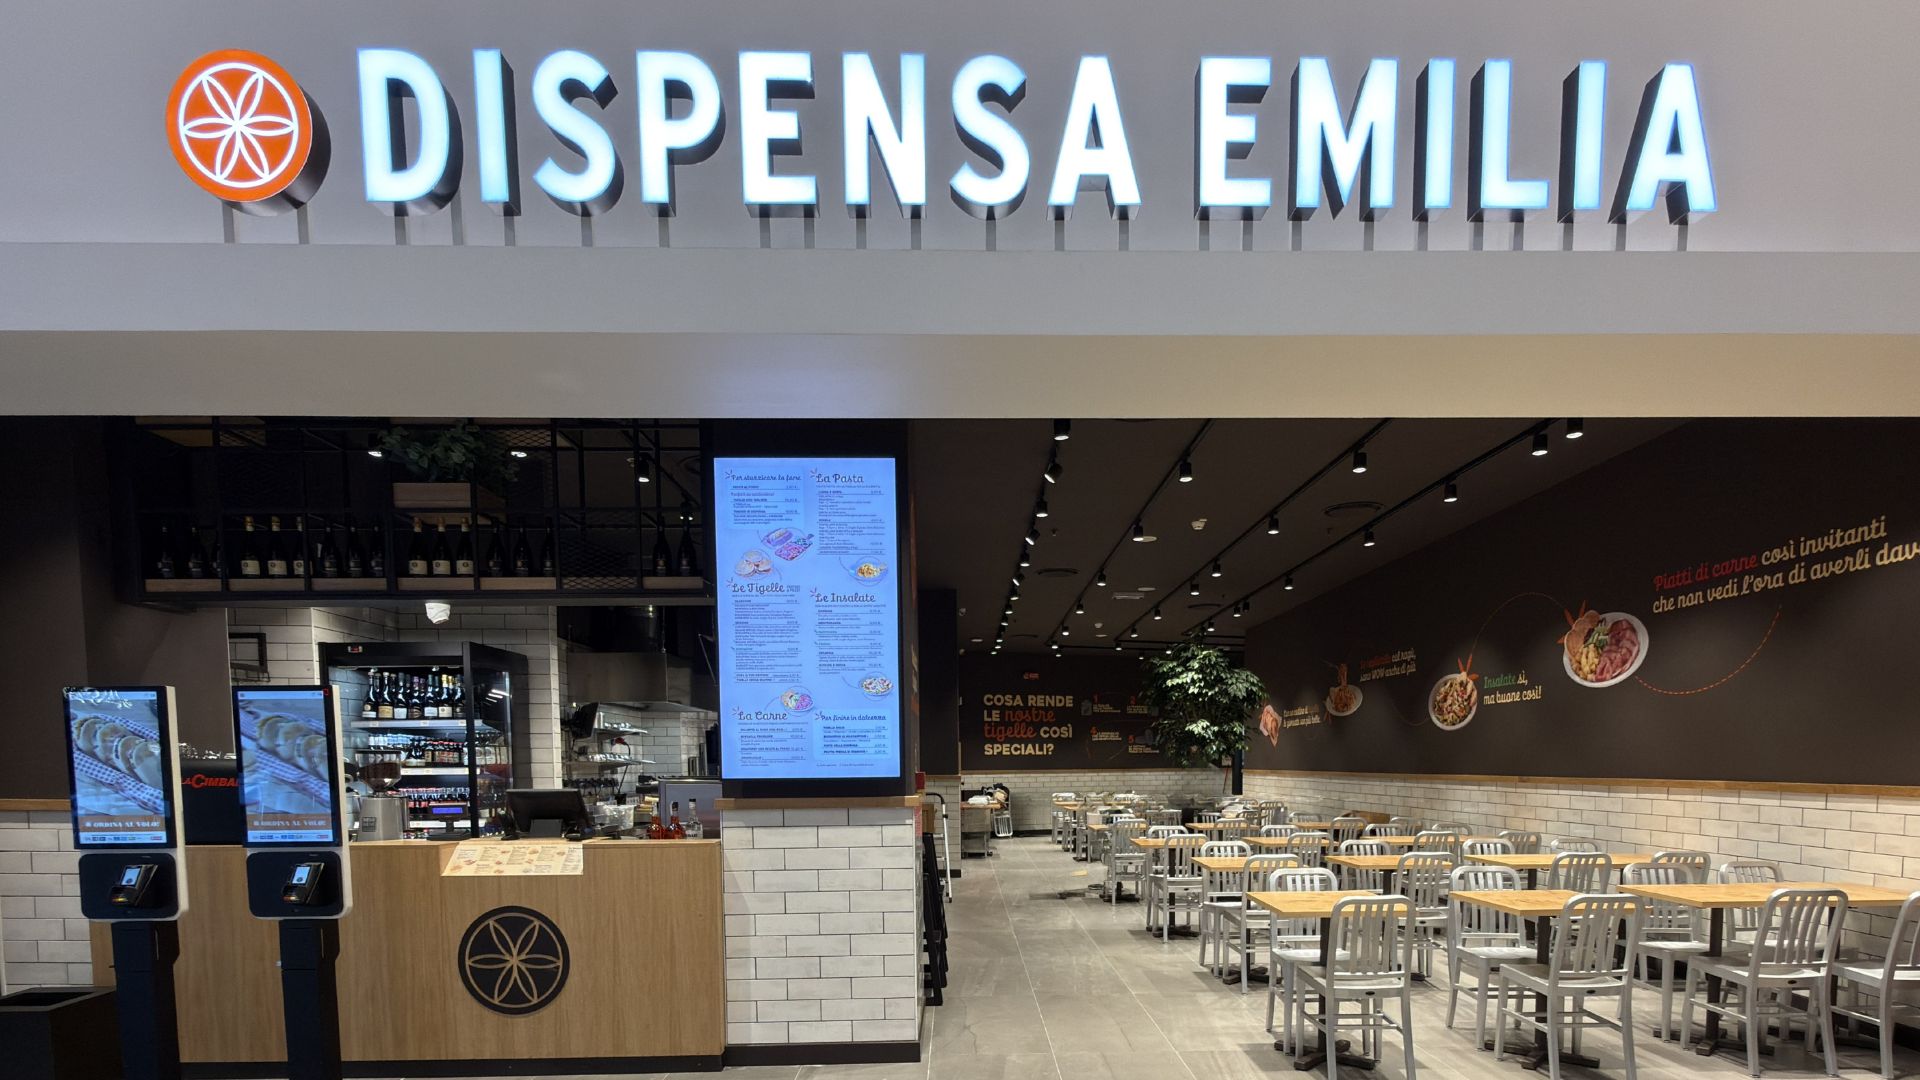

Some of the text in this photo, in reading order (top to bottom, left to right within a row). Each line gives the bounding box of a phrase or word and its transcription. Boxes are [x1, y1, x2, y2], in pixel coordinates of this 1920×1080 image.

[357, 48, 1717, 212] DISPENSA EMILIA
[816, 473, 864, 484] La Pasta
[1653, 515, 1888, 592] Piatti di carne così invitanti
[1652, 541, 1920, 614] che non vedi l'ora di averli dav
[732, 583, 747, 593] Le
[747, 582, 785, 595] Tigelle
[815, 592, 876, 603] Le Insalate
[1484, 672, 1516, 689] Insalate
[983, 694, 1074, 707] COSA RENDE
[1483, 685, 1542, 705] ma buone così!
[738, 711, 788, 721] La Carne
[983, 708, 1056, 722] LE nostre
[983, 723, 1037, 742] tigelle
[1039, 723, 1073, 738] COSÌ
[984, 743, 1055, 756] SPECIALI?
